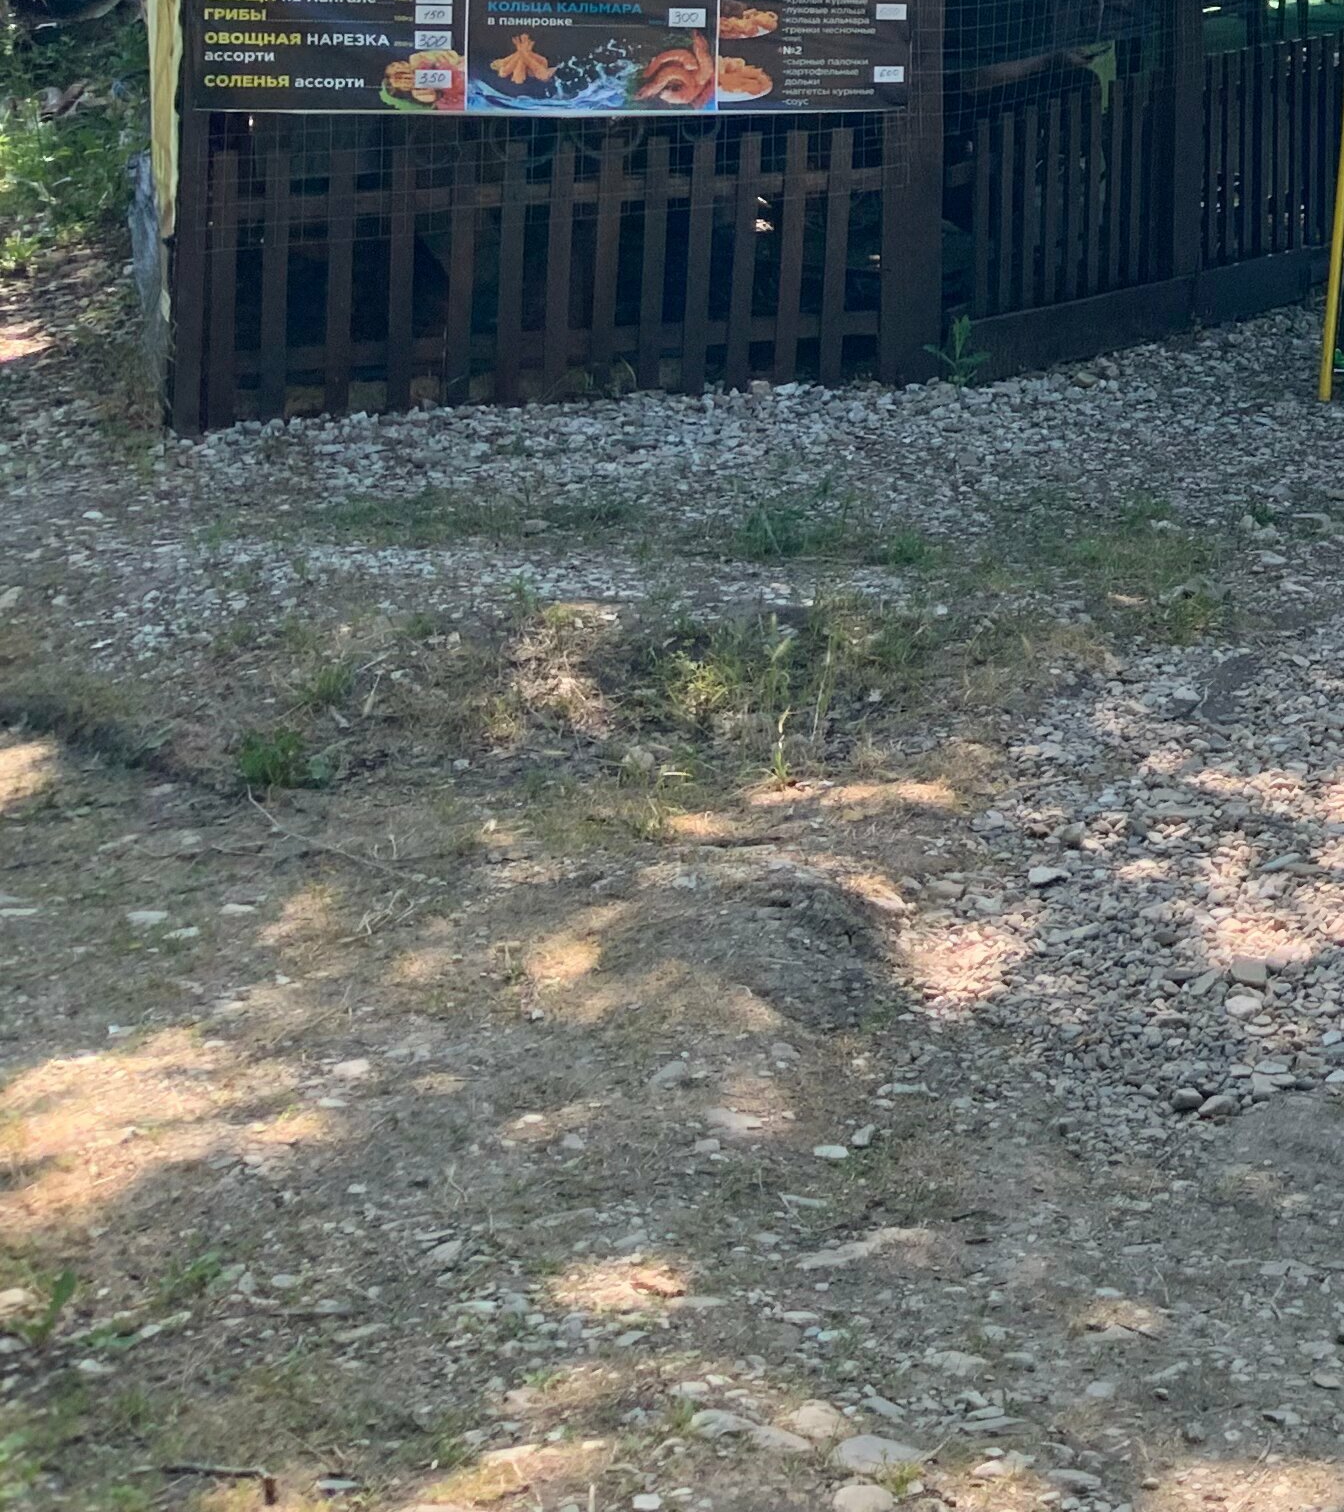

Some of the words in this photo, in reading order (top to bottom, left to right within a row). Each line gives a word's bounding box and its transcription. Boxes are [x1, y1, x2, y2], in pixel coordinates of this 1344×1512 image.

[488, 1, 551, 14] КОЛЬЦА
[557, 3, 642, 14] КАЛЬМАРА
[204, 8, 266, 21] ГРИБЫ
[488, 17, 495, 25] в
[499, 17, 572, 27] панировке
[205, 32, 301, 46] ОВОЩНАЯ
[307, 34, 390, 47] НАРЕЗКА
[205, 50, 274, 64] ассорти
[204, 75, 289, 87] СОЛЕНЬЯ
[295, 76, 364, 90] ассорти
